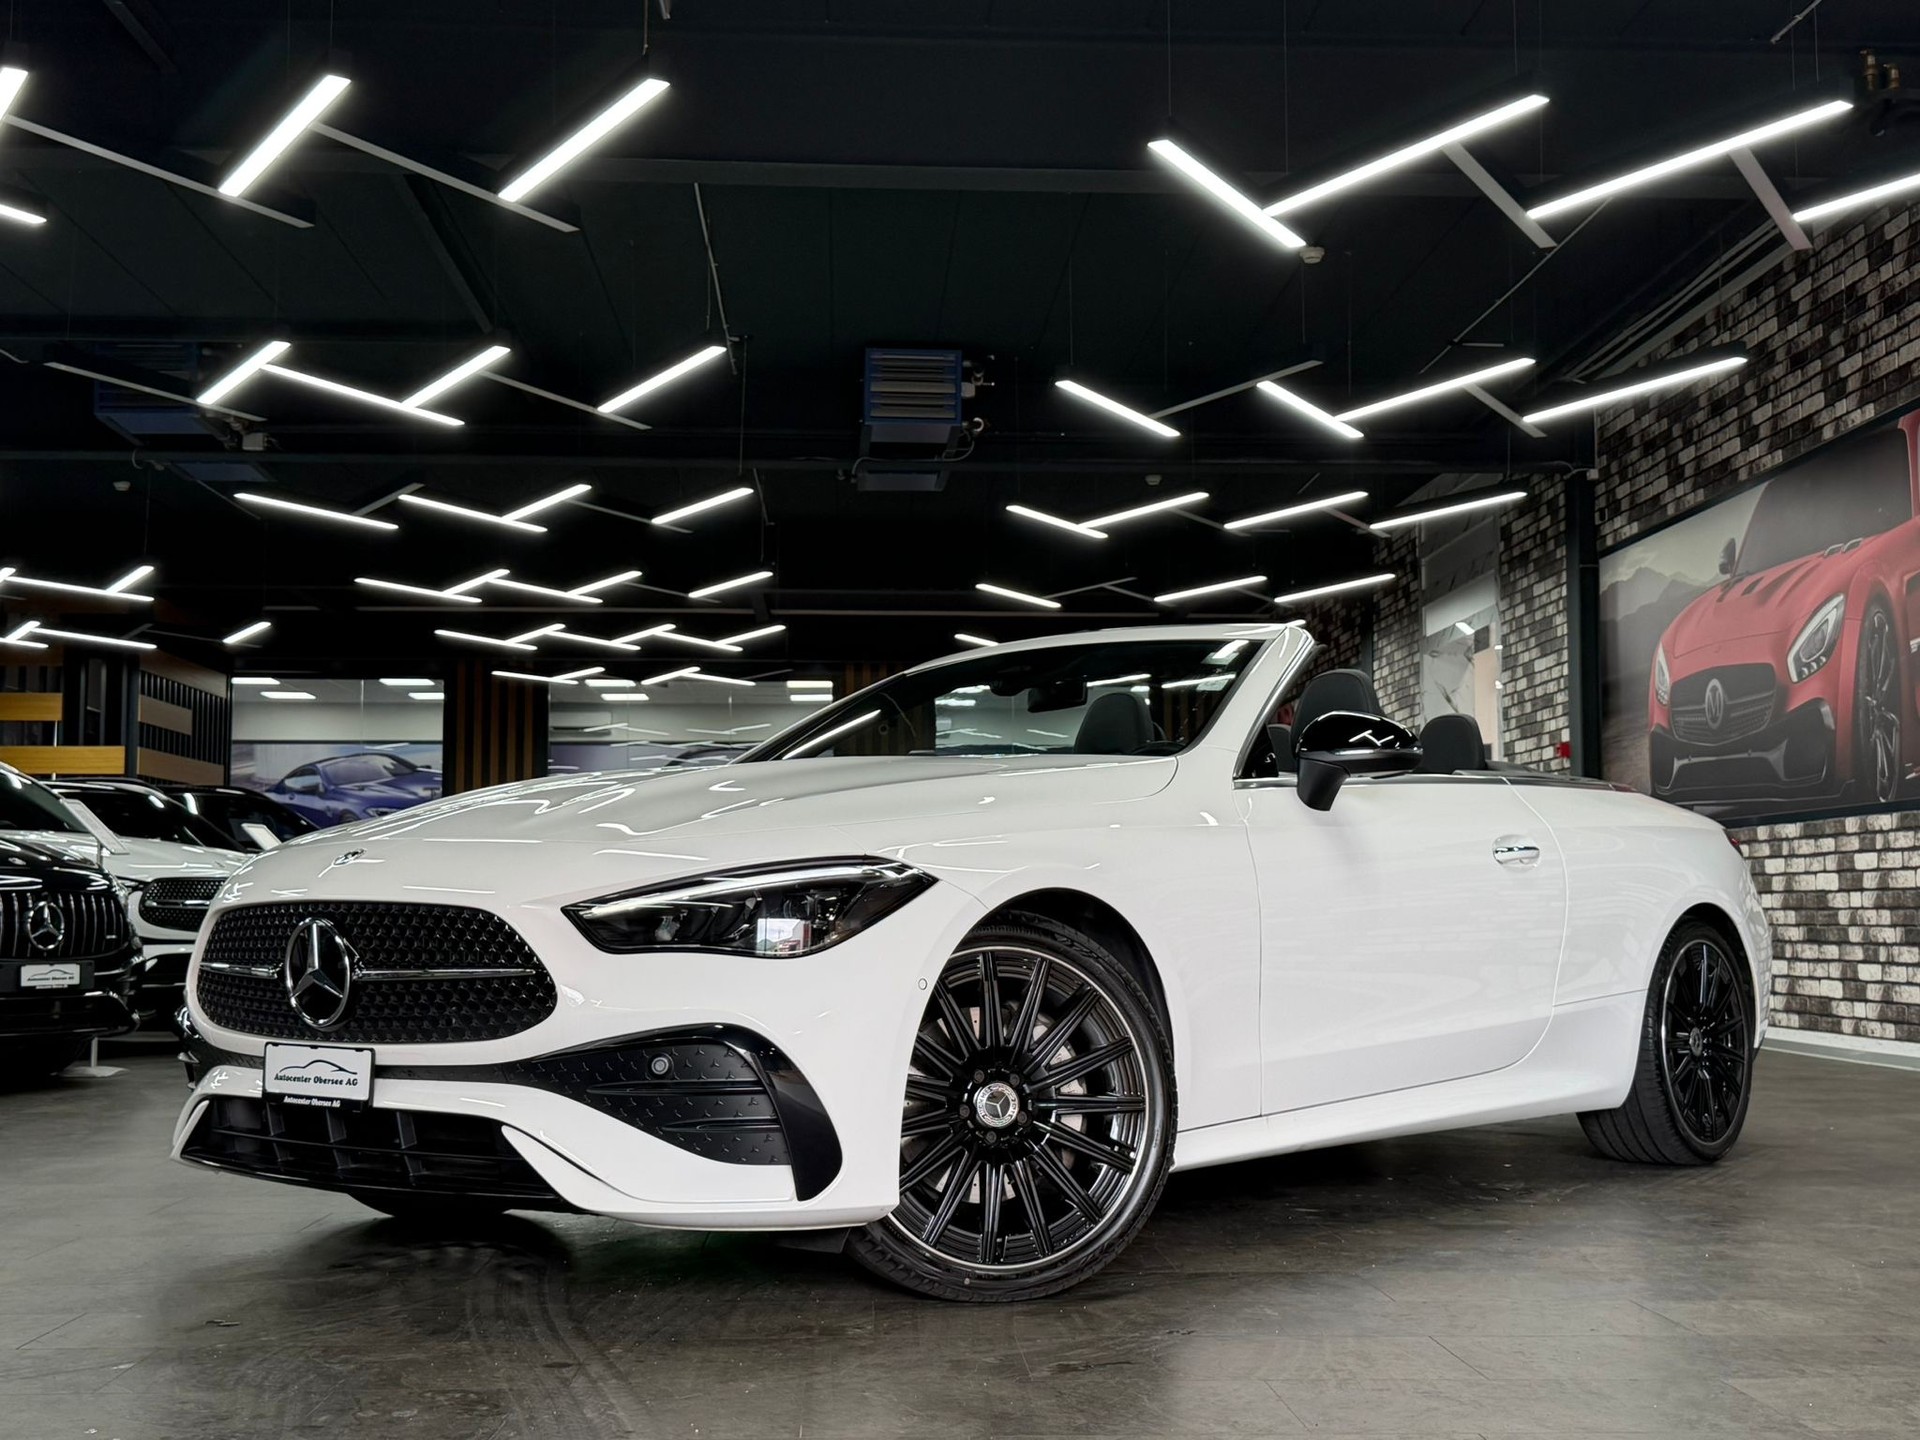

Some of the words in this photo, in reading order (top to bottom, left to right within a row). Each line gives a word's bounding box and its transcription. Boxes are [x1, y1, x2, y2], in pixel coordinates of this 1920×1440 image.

[274, 1073, 312, 1083] Autocenter
[313, 1076, 343, 1085] Obersee
[345, 1078, 358, 1086] AG
